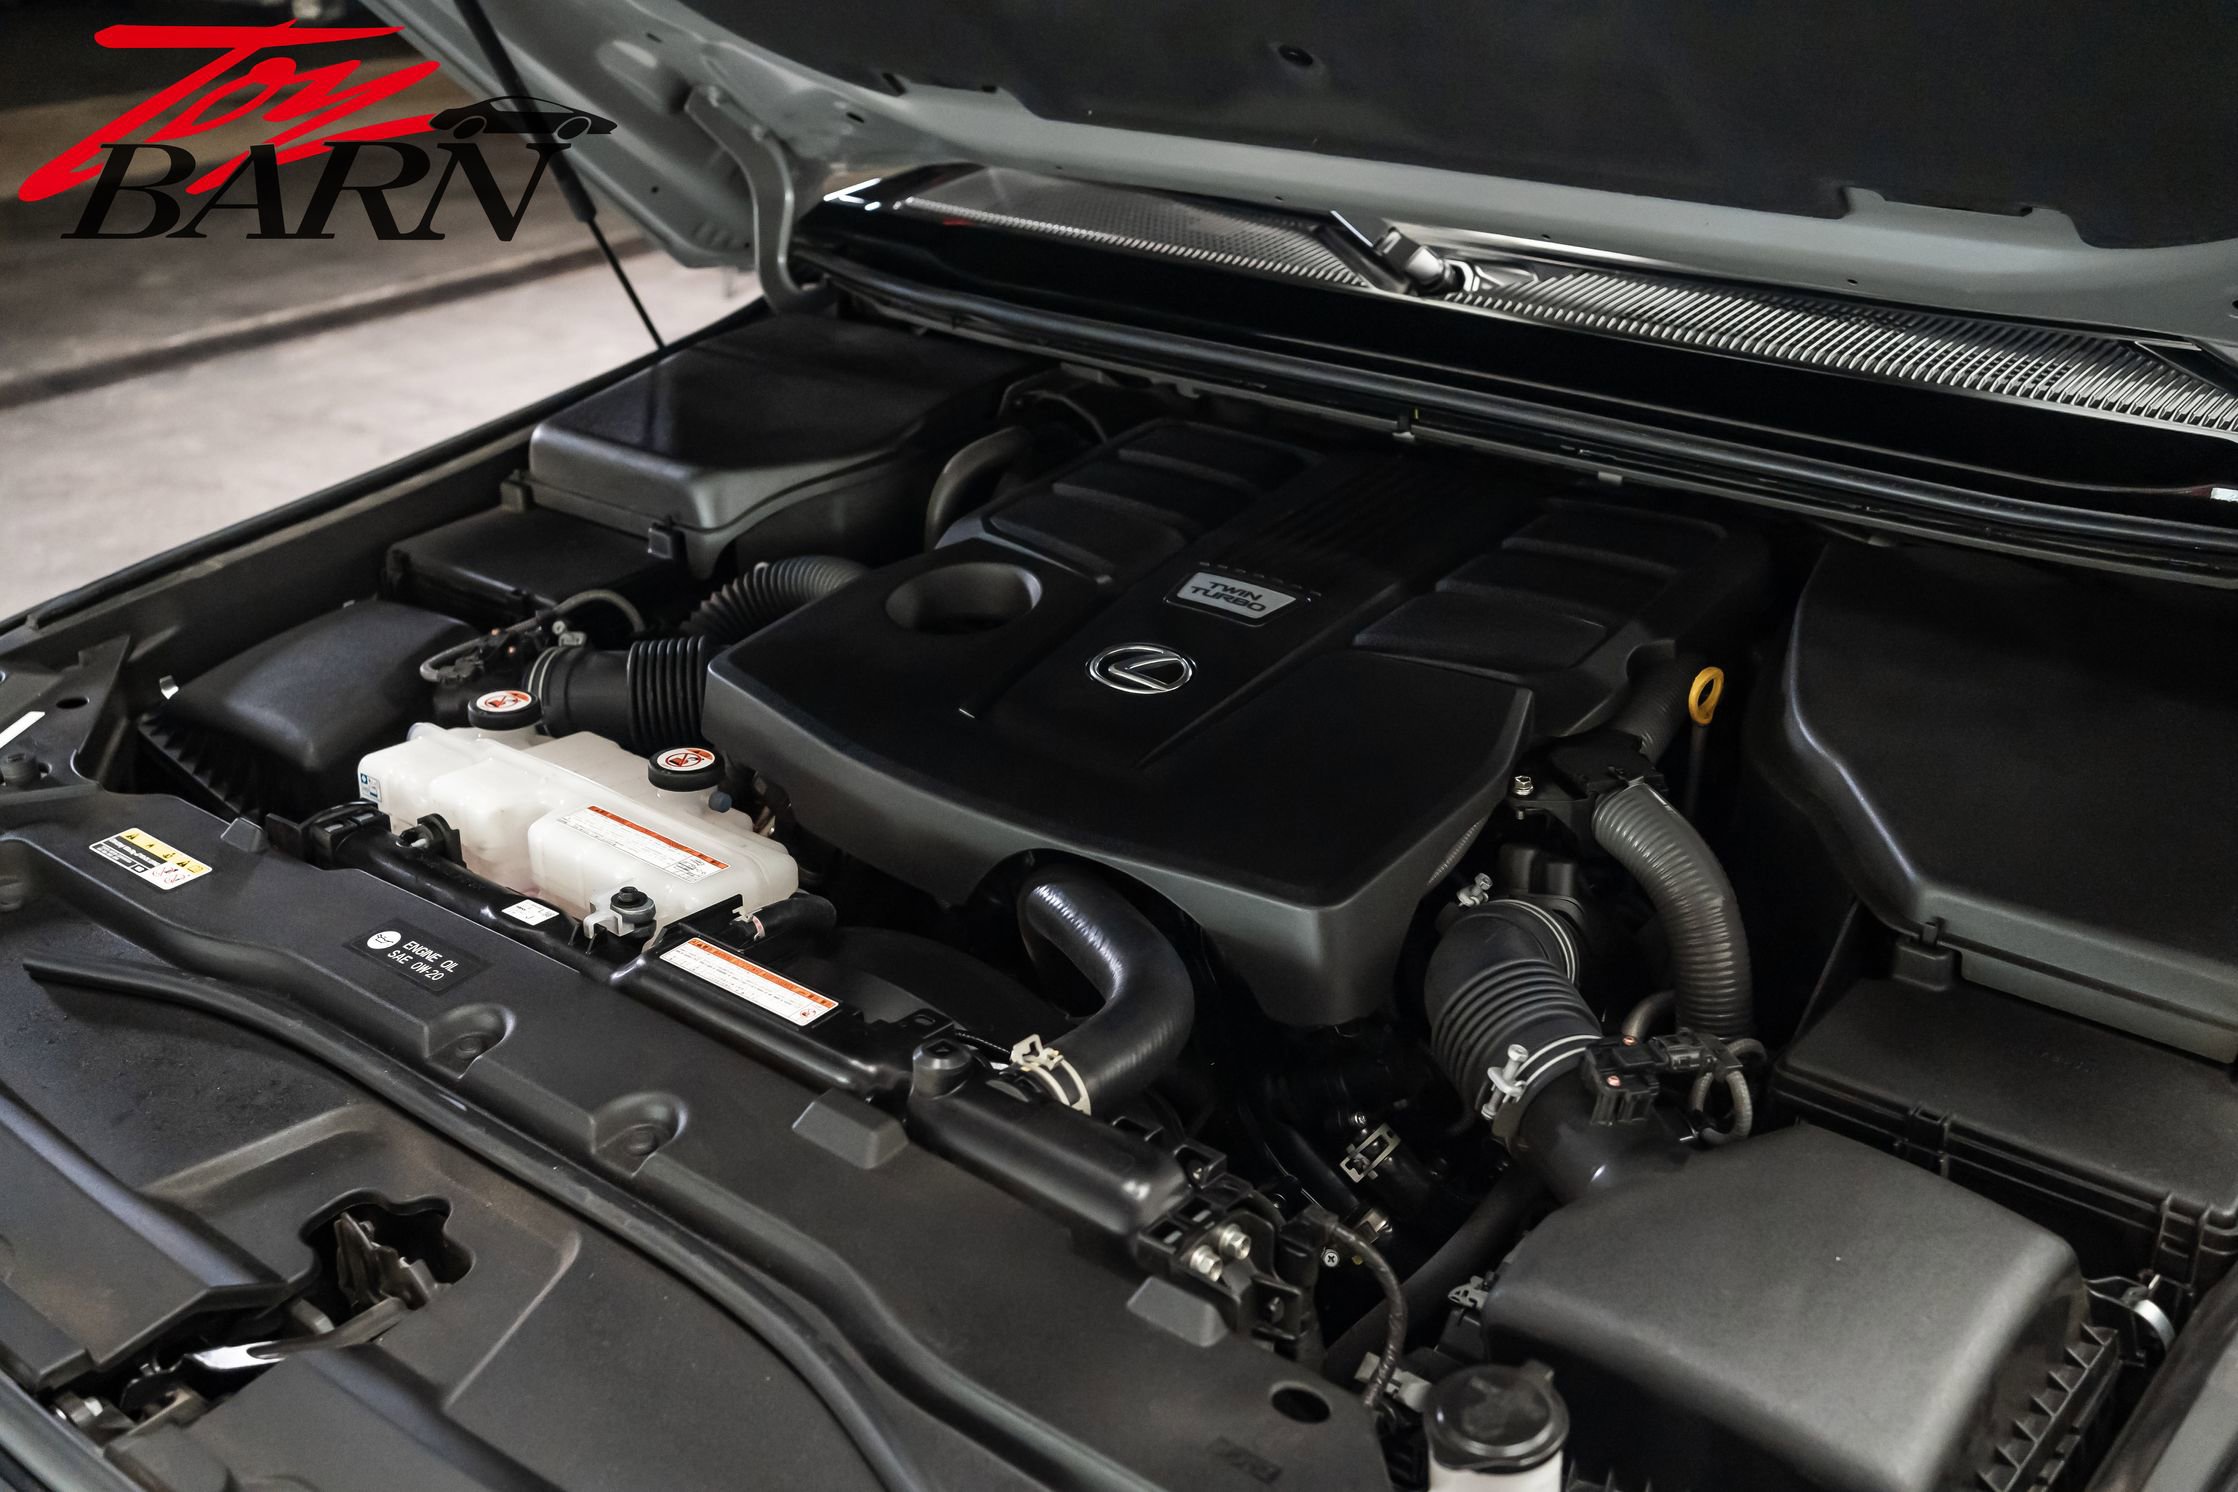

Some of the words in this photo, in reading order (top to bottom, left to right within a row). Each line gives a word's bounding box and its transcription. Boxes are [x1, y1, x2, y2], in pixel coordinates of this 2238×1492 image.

[1191, 586, 1266, 612] TURBO
[1209, 581, 1263, 601] TWIN
[387, 949, 413, 965] SAE
[402, 940, 443, 963] ENGINE
[440, 960, 459, 973] OIL
